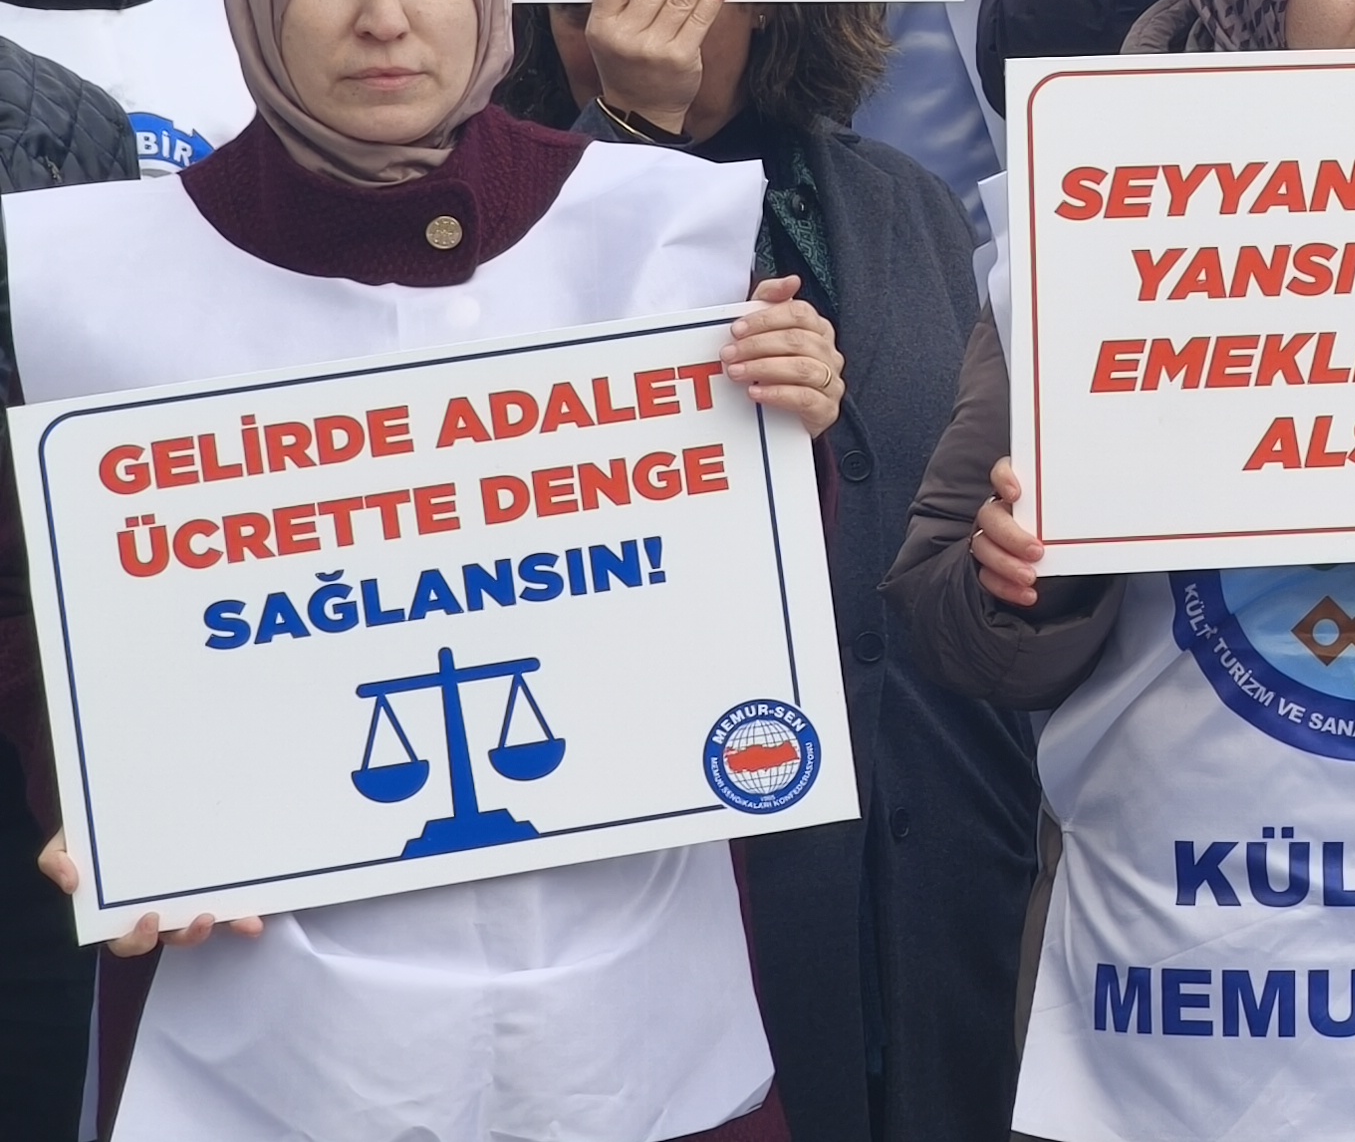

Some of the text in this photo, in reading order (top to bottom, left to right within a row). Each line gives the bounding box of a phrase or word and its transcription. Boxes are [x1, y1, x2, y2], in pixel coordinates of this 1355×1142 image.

[99, 361, 724, 494] GELİRDE ADALET
[117, 444, 729, 578] ÜCRETTE DENGE
[204, 536, 666, 650] SAĞLANSIN!
[712, 704, 806, 745] MEMUR-SEN
[1213, 638, 1275, 707] TURİZM
[1277, 697, 1306, 724] VE
